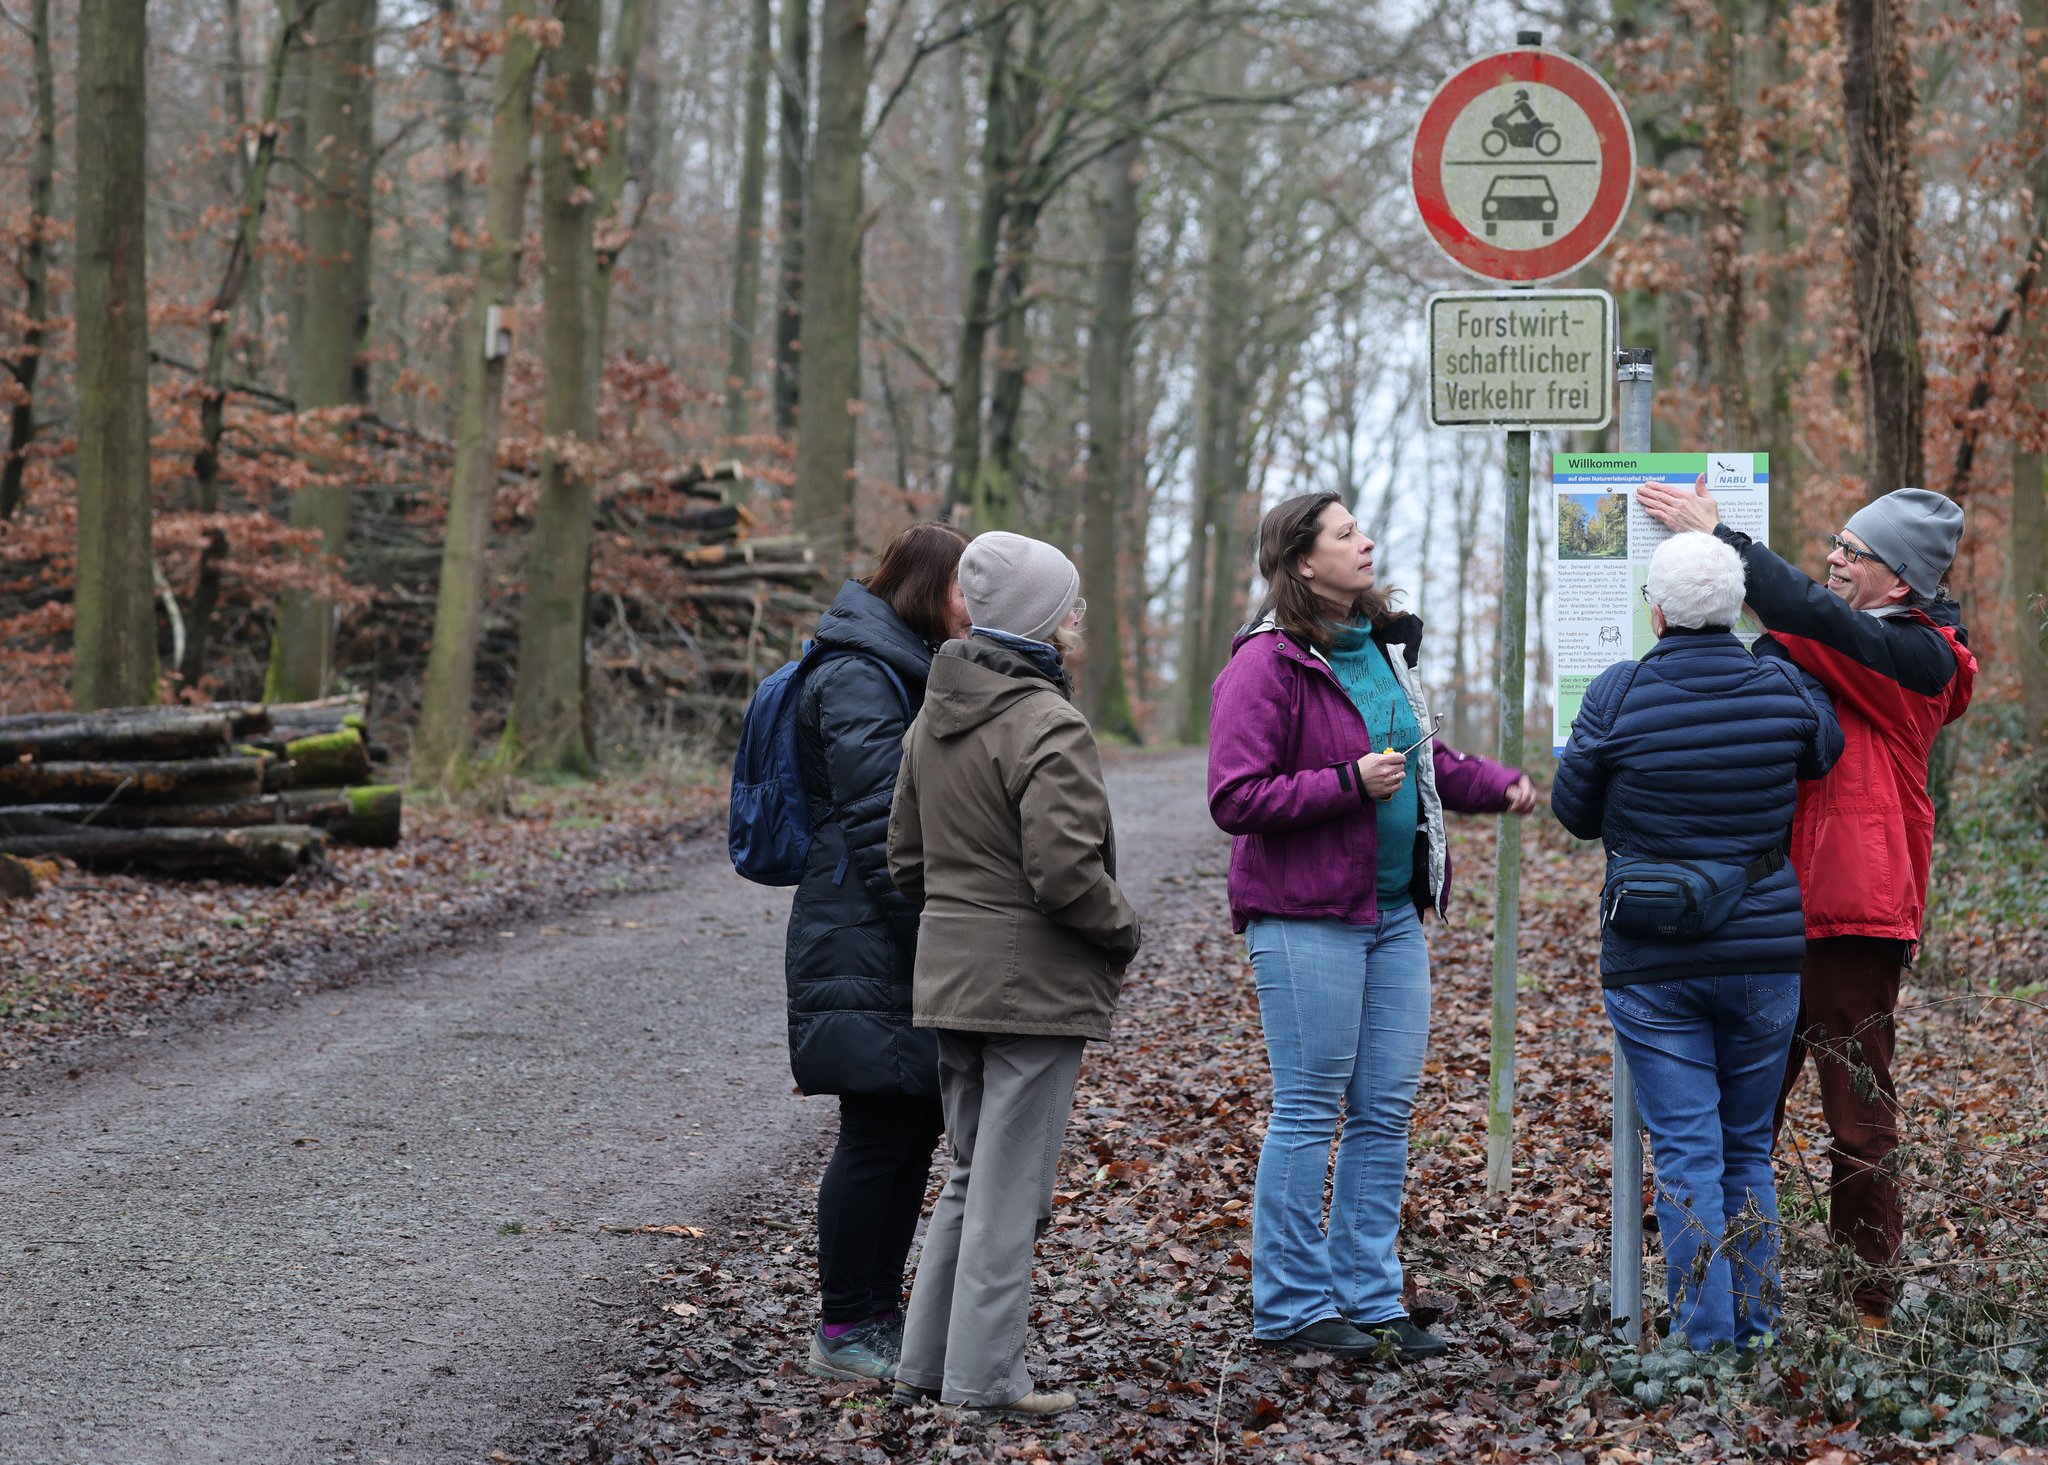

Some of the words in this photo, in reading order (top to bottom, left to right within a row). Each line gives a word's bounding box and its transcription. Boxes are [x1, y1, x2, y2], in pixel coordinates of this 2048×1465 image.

[1457, 308, 1585, 338] Forstwirt-
[1446, 344, 1592, 375] schaftlicher
[1445, 380, 1536, 411] Verkehr
[1547, 380, 1589, 409] frei
[1568, 458, 1637, 468] Willkommen
